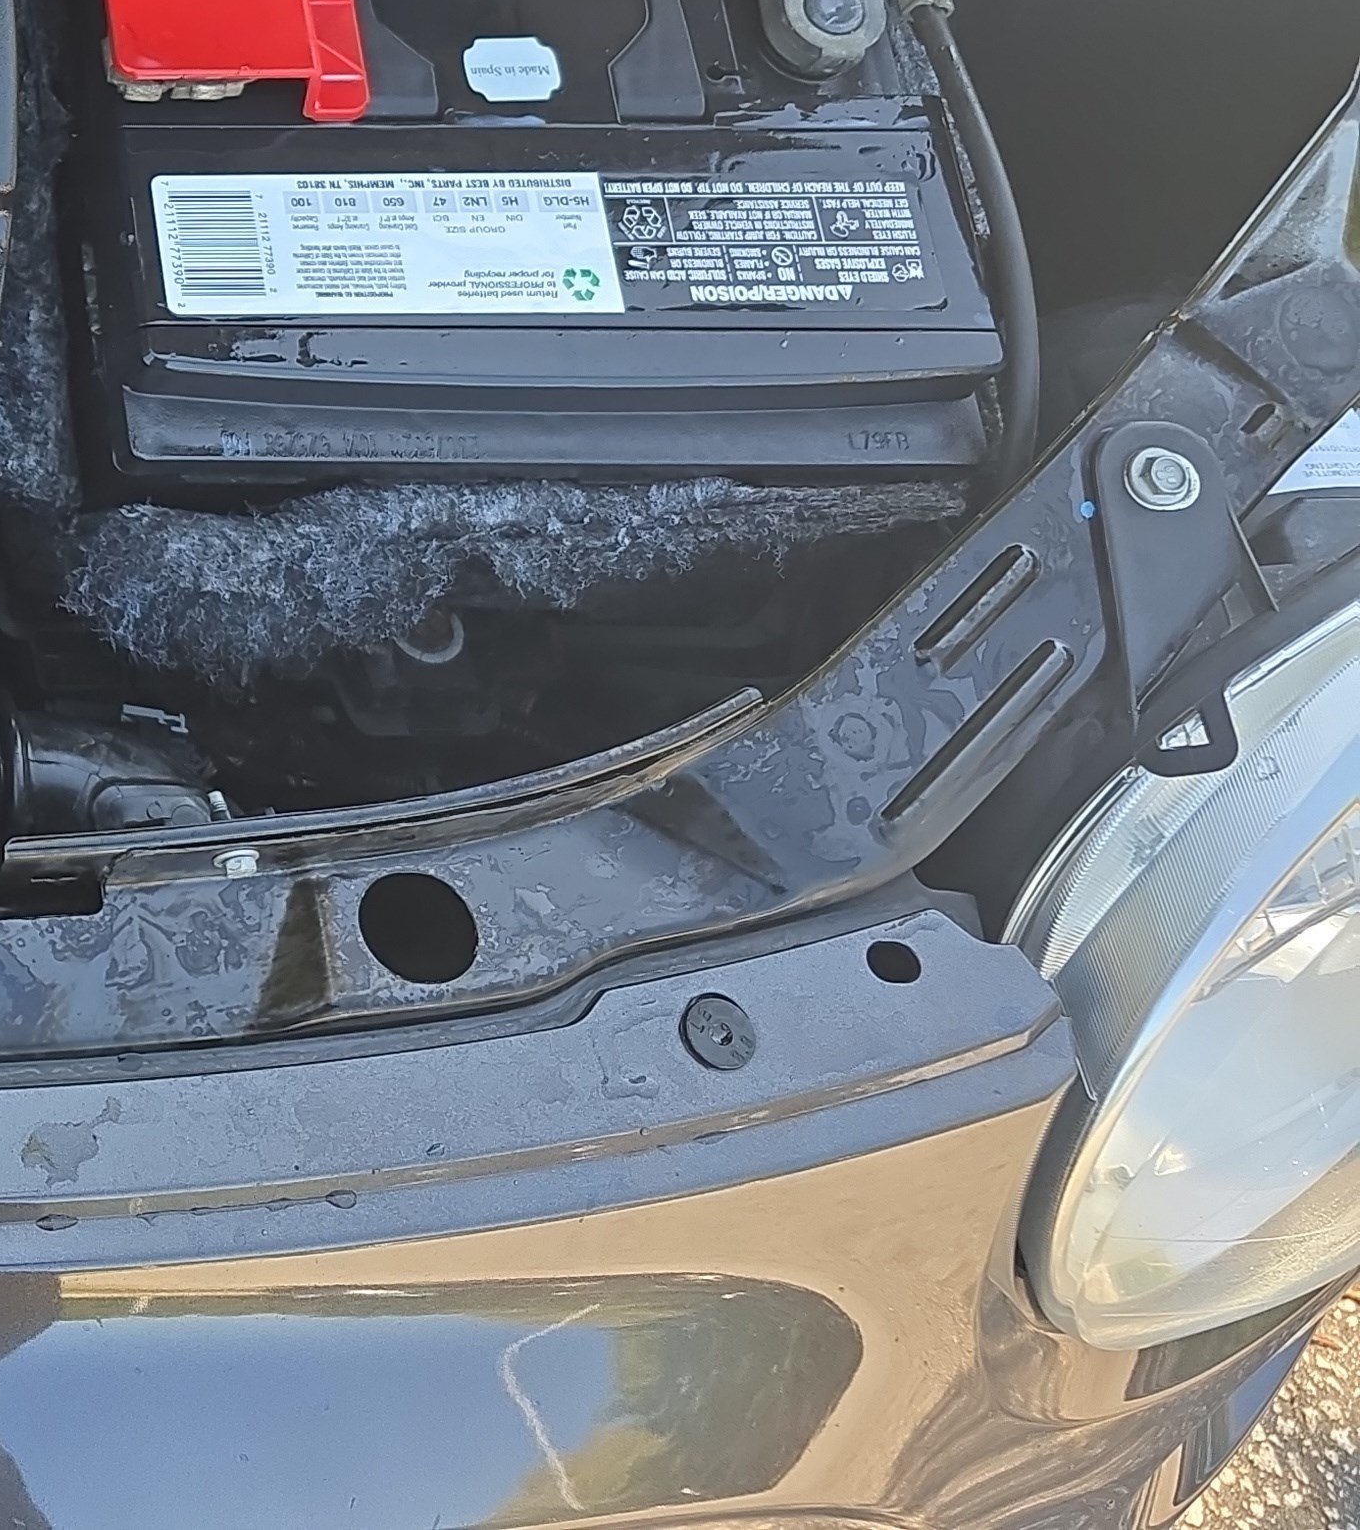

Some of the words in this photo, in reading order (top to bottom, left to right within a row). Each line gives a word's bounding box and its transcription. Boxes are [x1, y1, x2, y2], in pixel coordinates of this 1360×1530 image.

[470, 66, 501, 76] Spain
[505, 64, 516, 74] in
[518, 64, 550, 75] Made
[297, 180, 326, 189] 38103
[329, 180, 342, 189] TN
[341, 179, 395, 189] MEMPHIS,
[427, 178, 462, 188] PARTS,
[465, 178, 489, 188] BEST
[492, 179, 506, 188] BY
[508, 178, 572, 188] DISTRIBUTED
[642, 182, 663, 193] OPEN
[664, 182, 680, 193] NOT
[681, 182, 692, 193] DO
[712, 182, 729, 193] NOT
[730, 182, 743, 193] DO
[792, 182, 803, 192] OF
[804, 182, 832, 192] REACH
[833, 182, 850, 192] THE
[853, 182, 864, 192] OF
[865, 182, 883, 192] OUT
[884, 182, 905, 192] KEEP
[291, 197, 312, 207] 100
[335, 198, 356, 207] 810
[382, 197, 404, 207] 650
[432, 196, 447, 206] 47
[463, 196, 488, 206] LN2
[502, 196, 519, 206] H5
[544, 196, 590, 206] H5-DLG
[779, 200, 810, 209] SERVICE
[842, 199, 860, 208] HELP
[862, 199, 893, 208] MEDICAL
[894, 199, 909, 208] GET
[688, 211, 706, 220] SEEK
[749, 211, 763, 219] NOT
[773, 211, 785, 219] OR
[785, 211, 812, 219] MANUAL
[892, 210, 912, 218] WITH
[163, 202, 179, 241] 21112
[725, 221, 754, 229] VEHICLE
[755, 221, 763, 229] IN
[764, 221, 815, 229] INSTRUCTIONS
[865, 220, 914, 229] IMMEDIATELY
[258, 212, 271, 242] 21112
[445, 226, 467, 234] SIZE
[469, 225, 506, 233] GROUP
[676, 231, 706, 240] FOLLOW
[745, 231, 765, 240] JUMP
[766, 231, 780, 240] FOR
[873, 230, 891, 239] EYES
[891, 230, 917, 239] FLUSH
[666, 247, 692, 256] BURNS
[692, 247, 721, 256] SEVERE
[729, 248, 761, 257] SMOKING
[798, 247, 825, 256] INJURY
[826, 247, 838, 256] OR
[838, 247, 879, 256] BLINDNESS
[880, 247, 906, 256] CAUSE
[906, 246, 920, 256] CAN
[262, 245, 276, 275] 77390
[670, 259, 682, 267] OR
[683, 259, 724, 268] BLINDNESS
[734, 260, 764, 268] FLAMES
[814, 258, 841, 269] GASES
[842, 258, 886, 268] EXPLOSIVE
[170, 247, 185, 285] 77390
[464, 270, 506, 278] recycling
[624, 270, 649, 281] CAUSE
[649, 271, 666, 280] CAN
[667, 270, 686, 280] ACID
[687, 270, 727, 280] SULFURIC
[737, 271, 766, 280] SPARKS
[777, 267, 795, 281] NO
[838, 272, 860, 282] EYES
[861, 272, 889, 283] SHIELD
[468, 281, 545, 289] PROFESSIONAL
[458, 290, 501, 298] batteries
[527, 290, 558, 298] Return
[689, 285, 840, 301] DANGER/POISON
